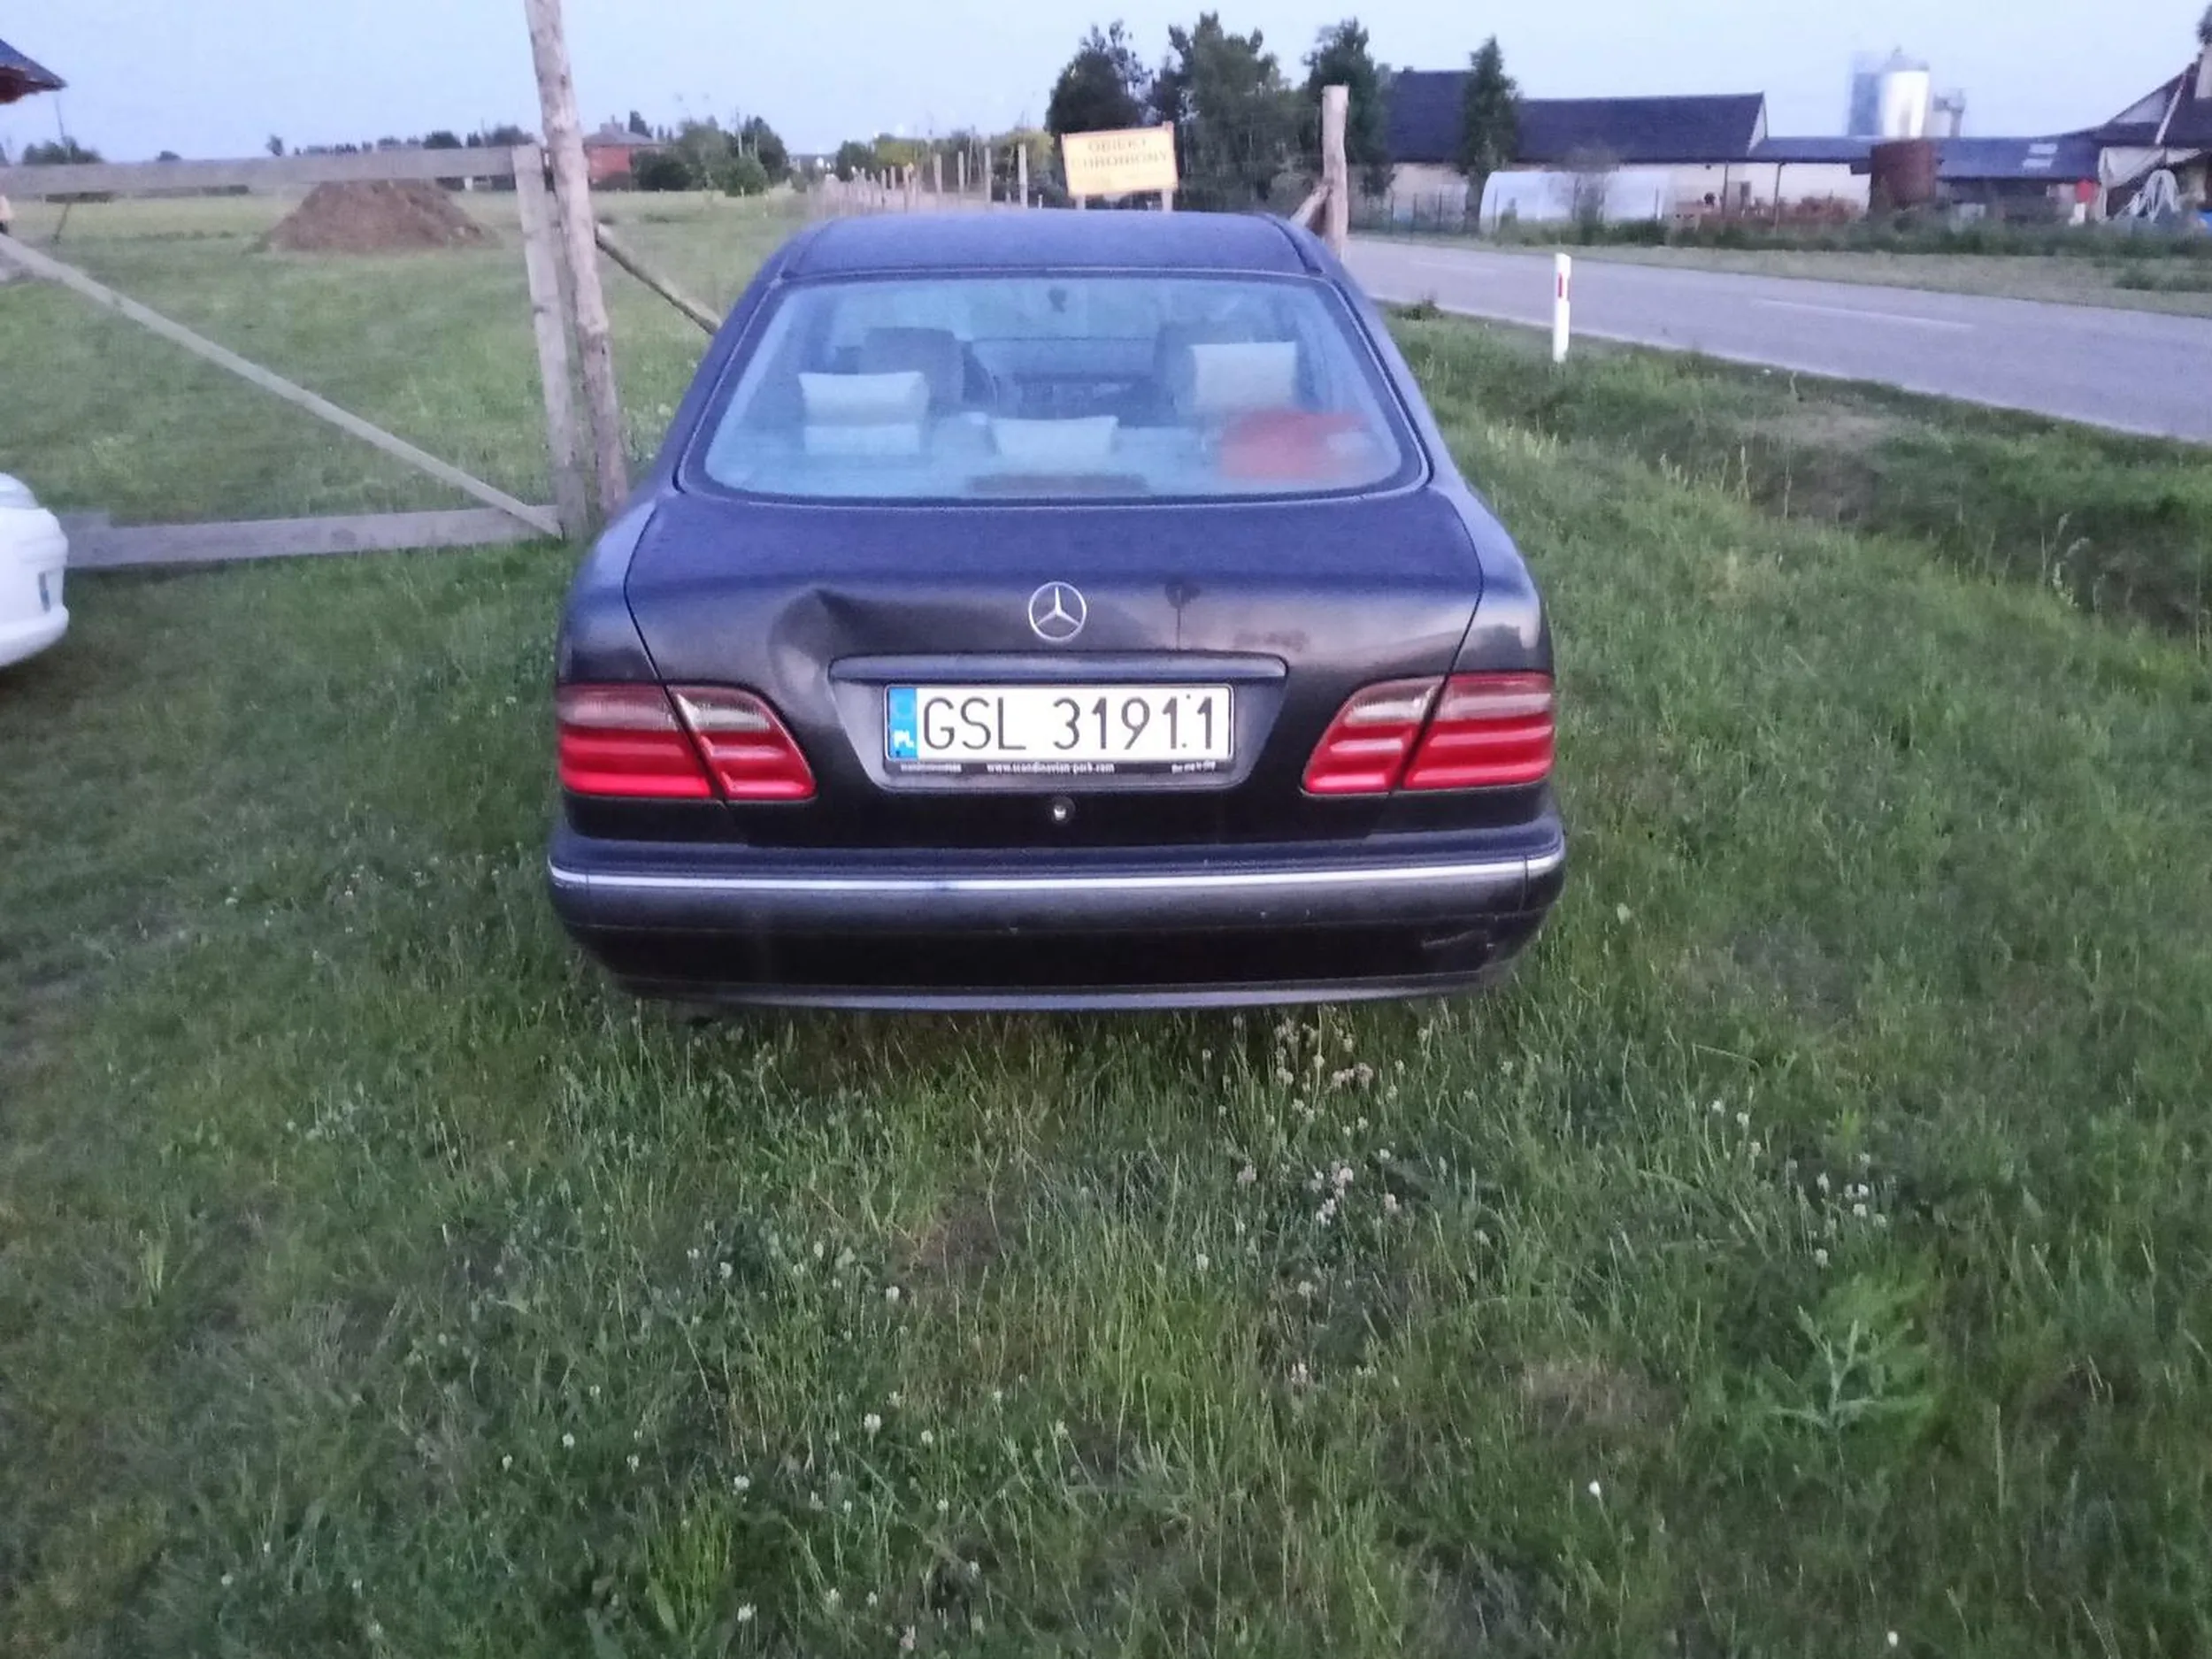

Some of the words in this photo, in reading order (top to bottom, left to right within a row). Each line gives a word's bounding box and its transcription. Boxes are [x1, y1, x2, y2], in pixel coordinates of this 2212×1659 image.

[894, 730, 914, 748] PL
[923, 696, 1026, 750] GSL
[1052, 696, 1214, 750] 31911
